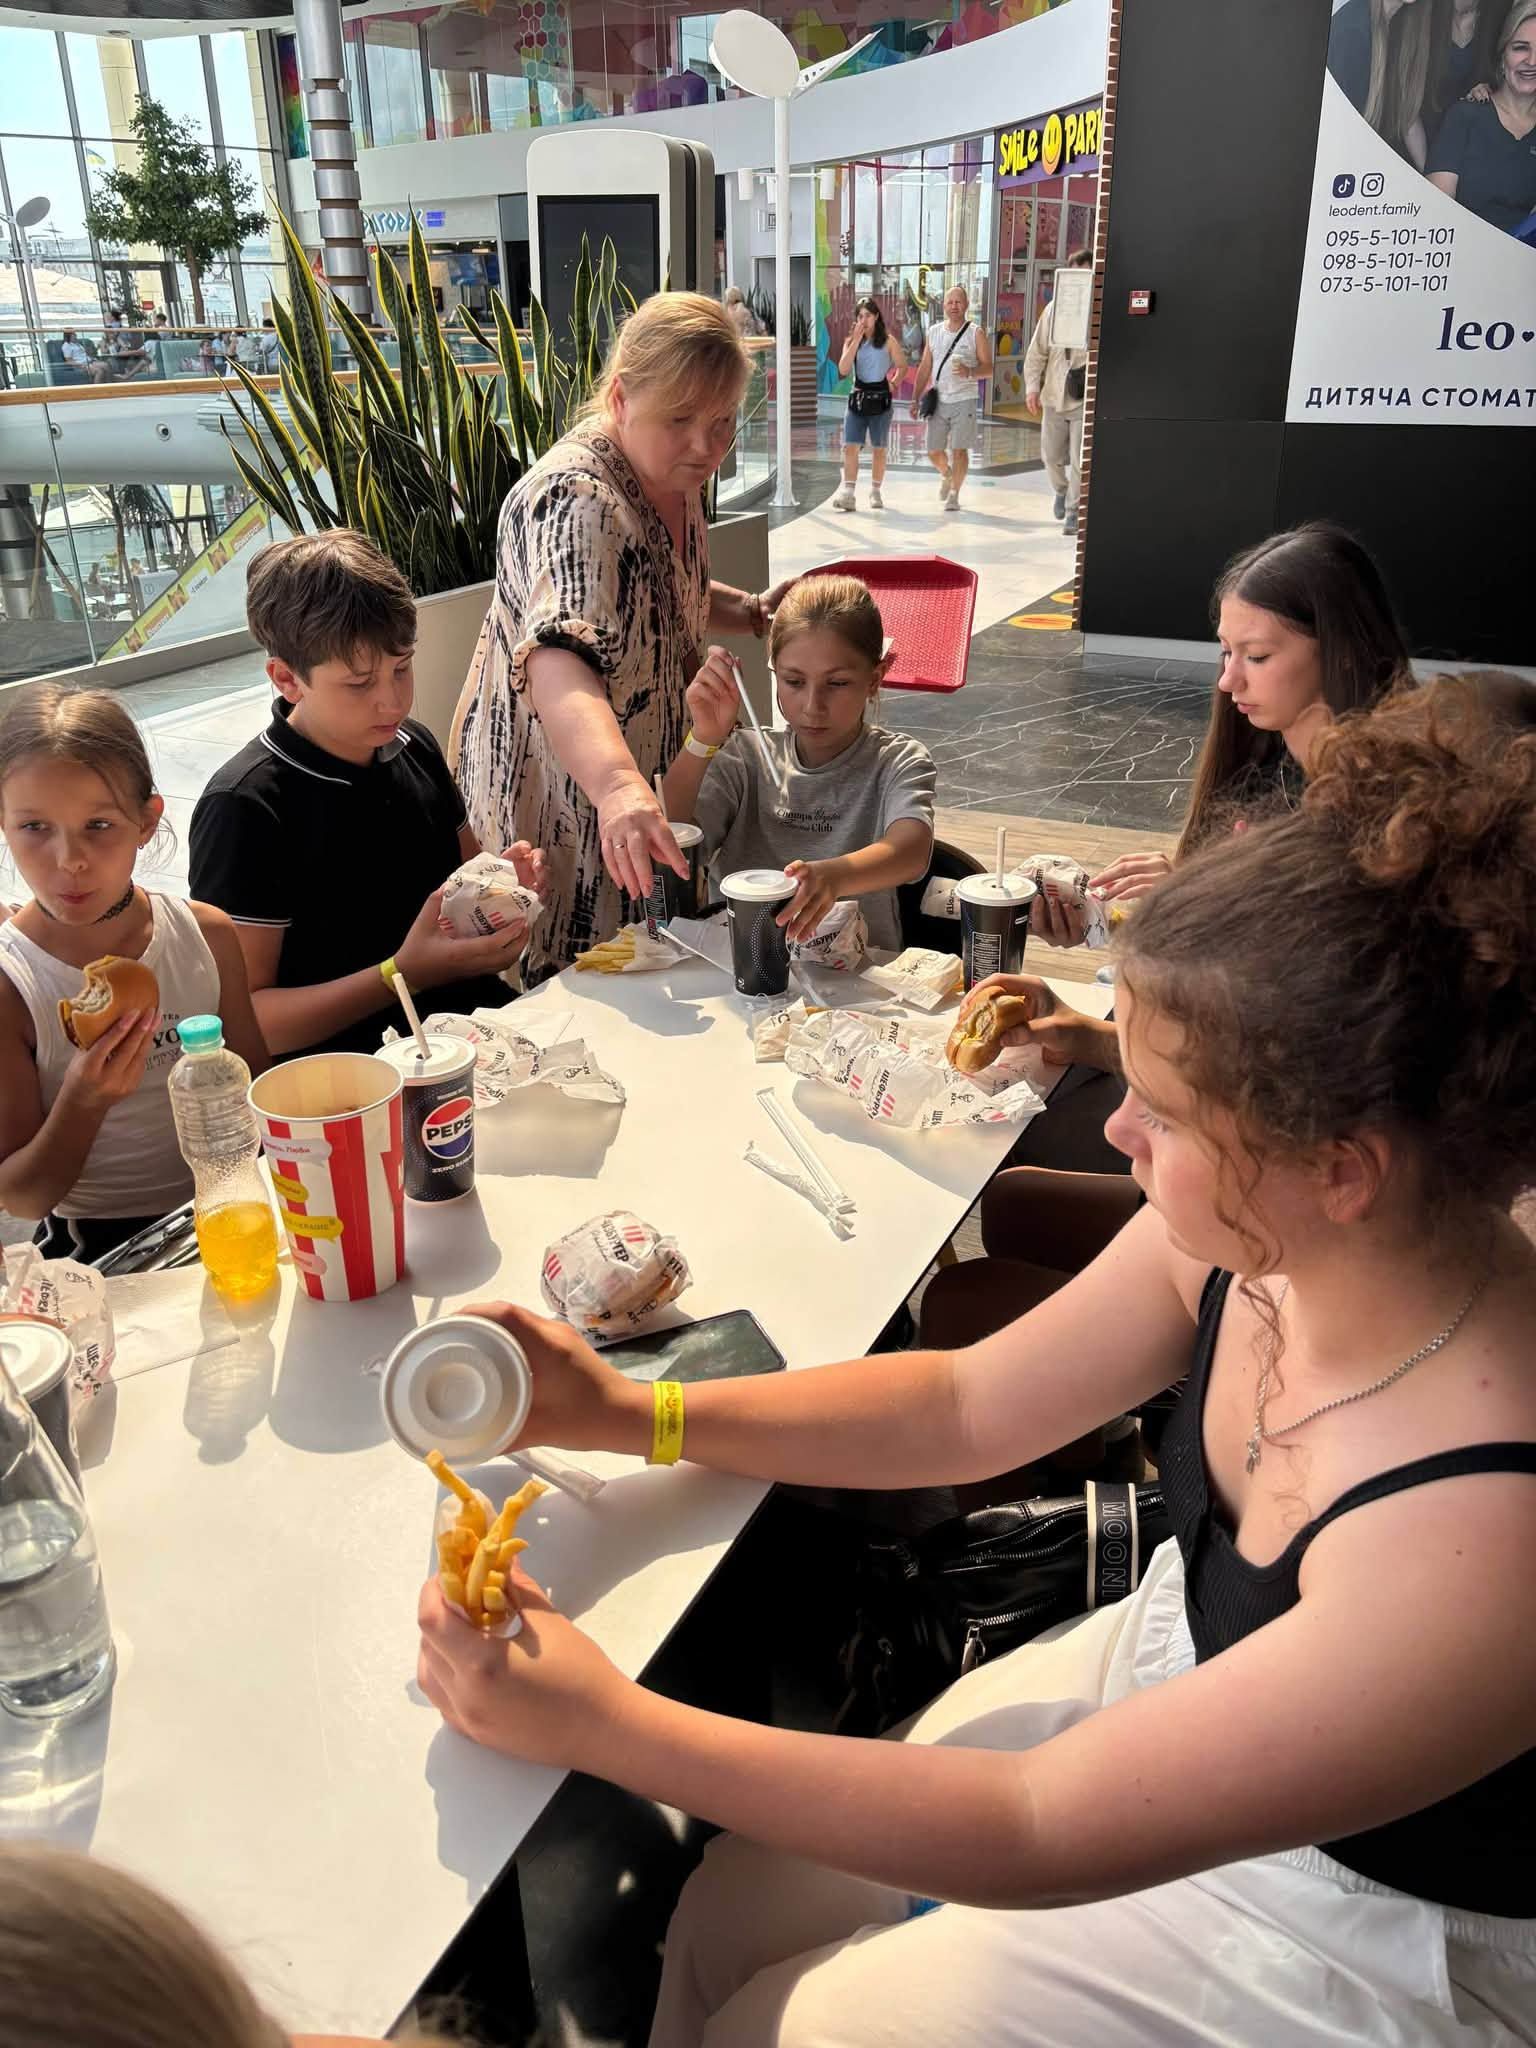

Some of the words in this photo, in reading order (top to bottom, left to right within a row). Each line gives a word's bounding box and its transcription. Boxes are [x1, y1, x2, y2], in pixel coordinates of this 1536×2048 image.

[1328, 202, 1421, 217] leodent.family
[1326, 228, 1455, 247] 095-5-101-101
[1323, 252, 1451, 270] 098-5-101-101
[1320, 275, 1448, 293] 073-5-101-101
[1436, 306, 1515, 351] leo
[1305, 387, 1412, 409] ДИТЯЧА
